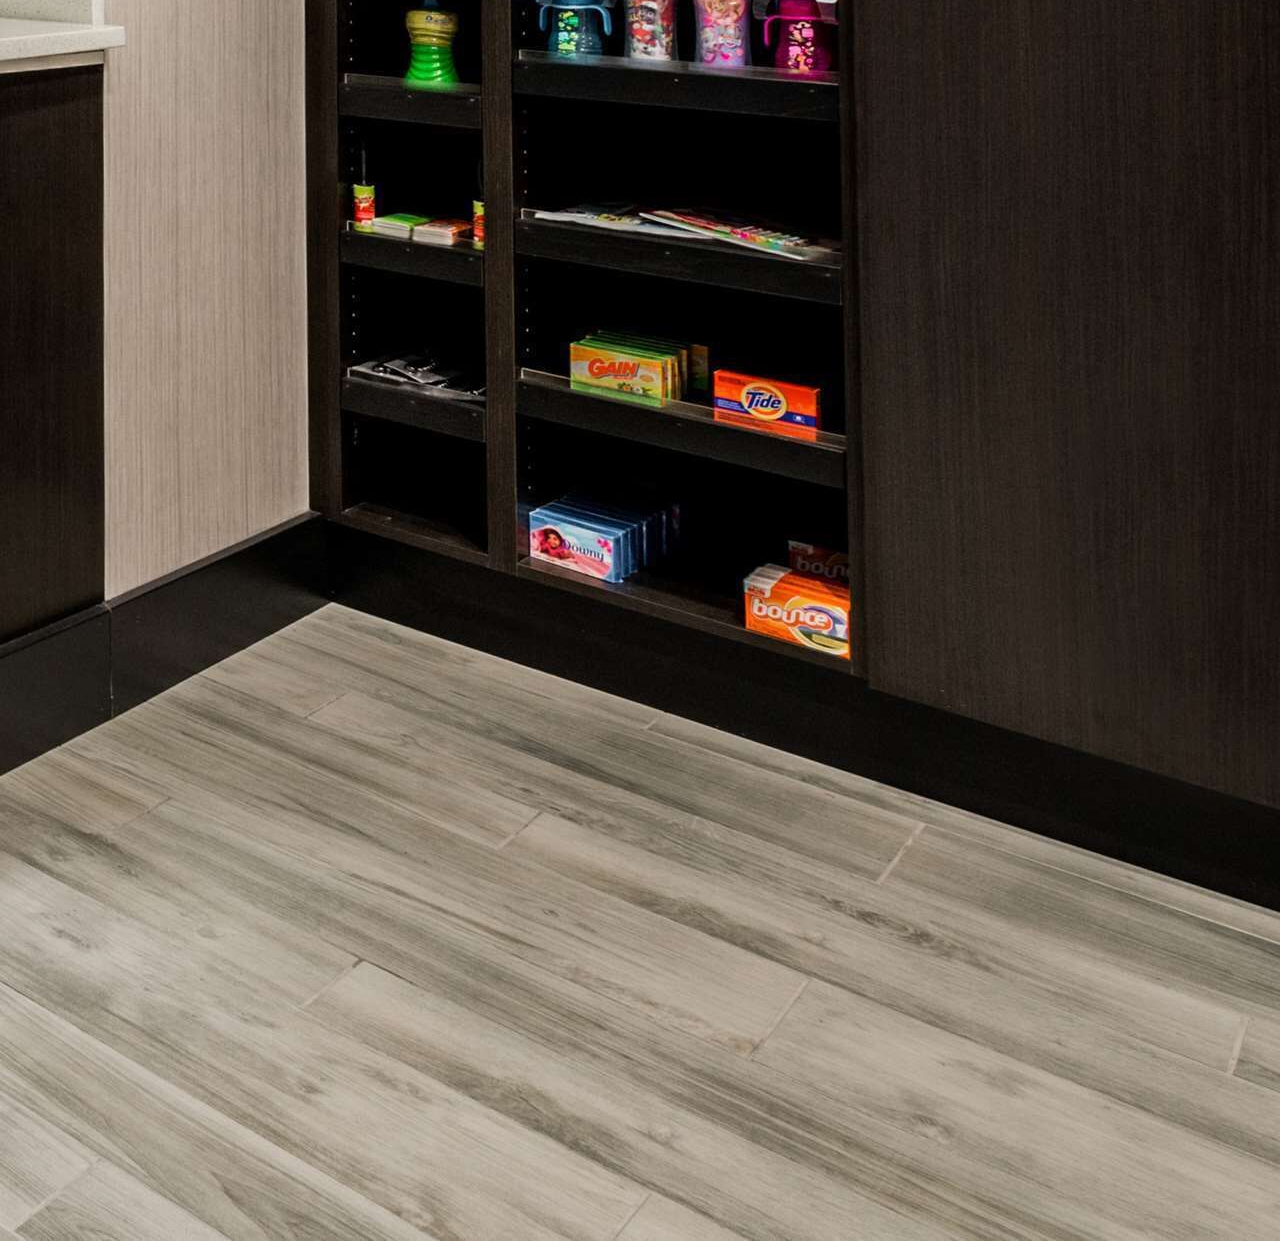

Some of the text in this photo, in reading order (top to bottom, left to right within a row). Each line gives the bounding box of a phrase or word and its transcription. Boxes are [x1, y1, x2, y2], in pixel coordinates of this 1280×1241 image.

[745, 391, 782, 409] Tide
[562, 539, 604, 562] Downy
[752, 597, 828, 628] bounce
